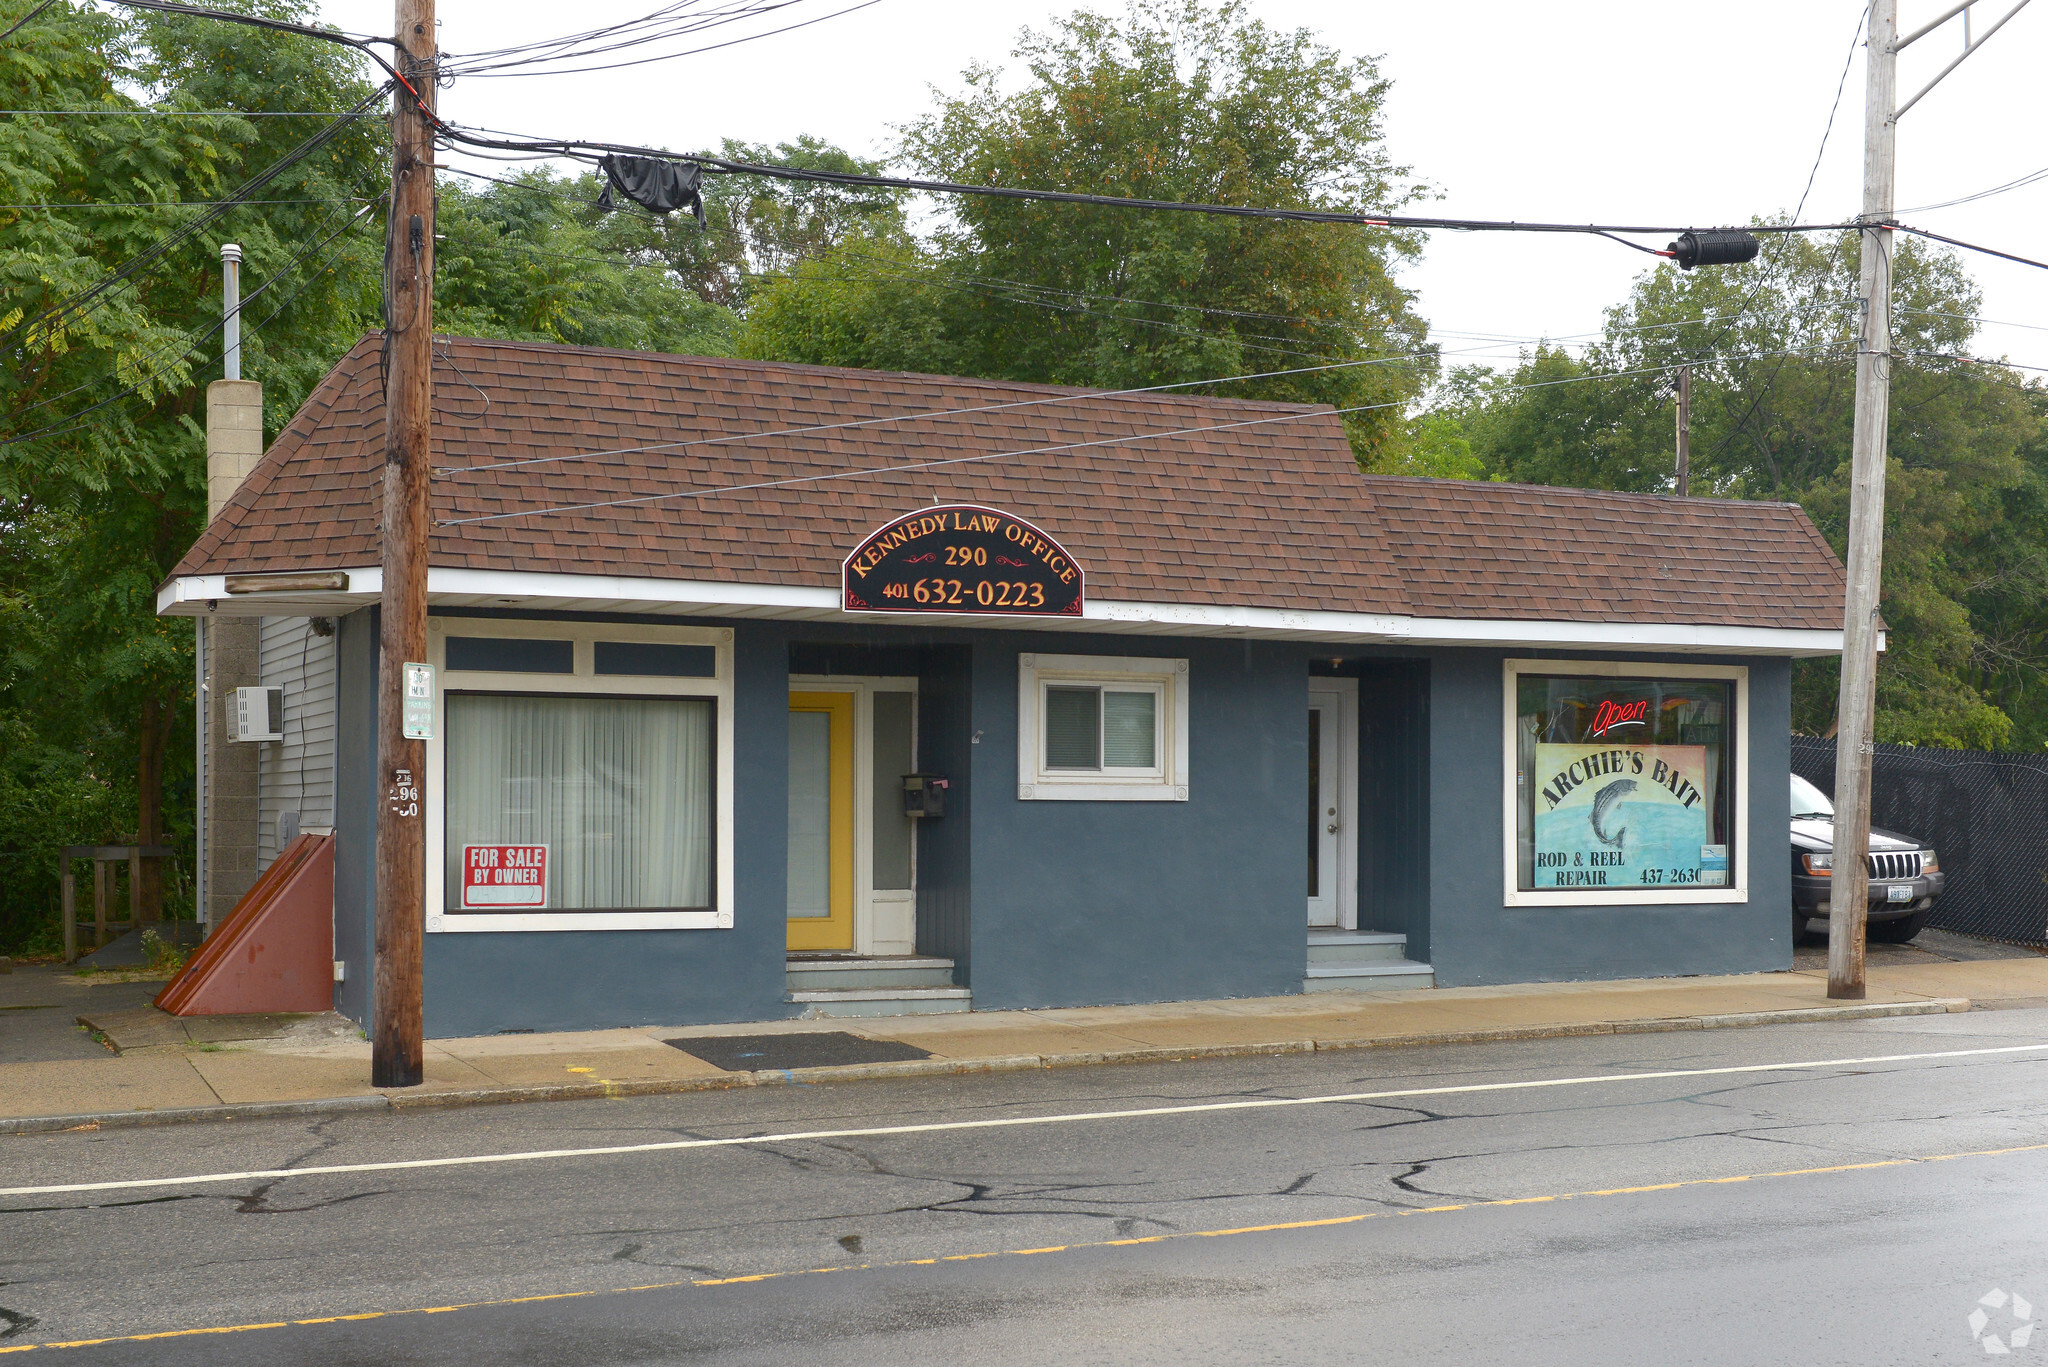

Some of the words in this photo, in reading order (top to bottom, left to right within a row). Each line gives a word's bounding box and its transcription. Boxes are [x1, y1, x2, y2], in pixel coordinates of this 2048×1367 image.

[851, 514, 948, 579] KENNEDY
[954, 512, 1001, 534] LAW
[1005, 523, 1077, 585] OFFICE
[944, 546, 988, 567] 290
[882, 582, 909, 599] 401
[913, 578, 1046, 607] 632-0223
[1593, 700, 1647, 736] Open
[1686, 726, 1719, 742] ATM
[1541, 750, 1644, 811] ARCHIE'S
[1651, 758, 1702, 810] BAIT
[470, 848, 499, 868] FOR
[505, 848, 543, 868] SALE
[1537, 852, 1567, 868] ROD
[1573, 852, 1584, 867] &
[1590, 851, 1625, 867] REEL
[474, 868, 490, 884] BY
[494, 868, 538, 884] OWNER
[1555, 870, 1608, 886] REPAIR
